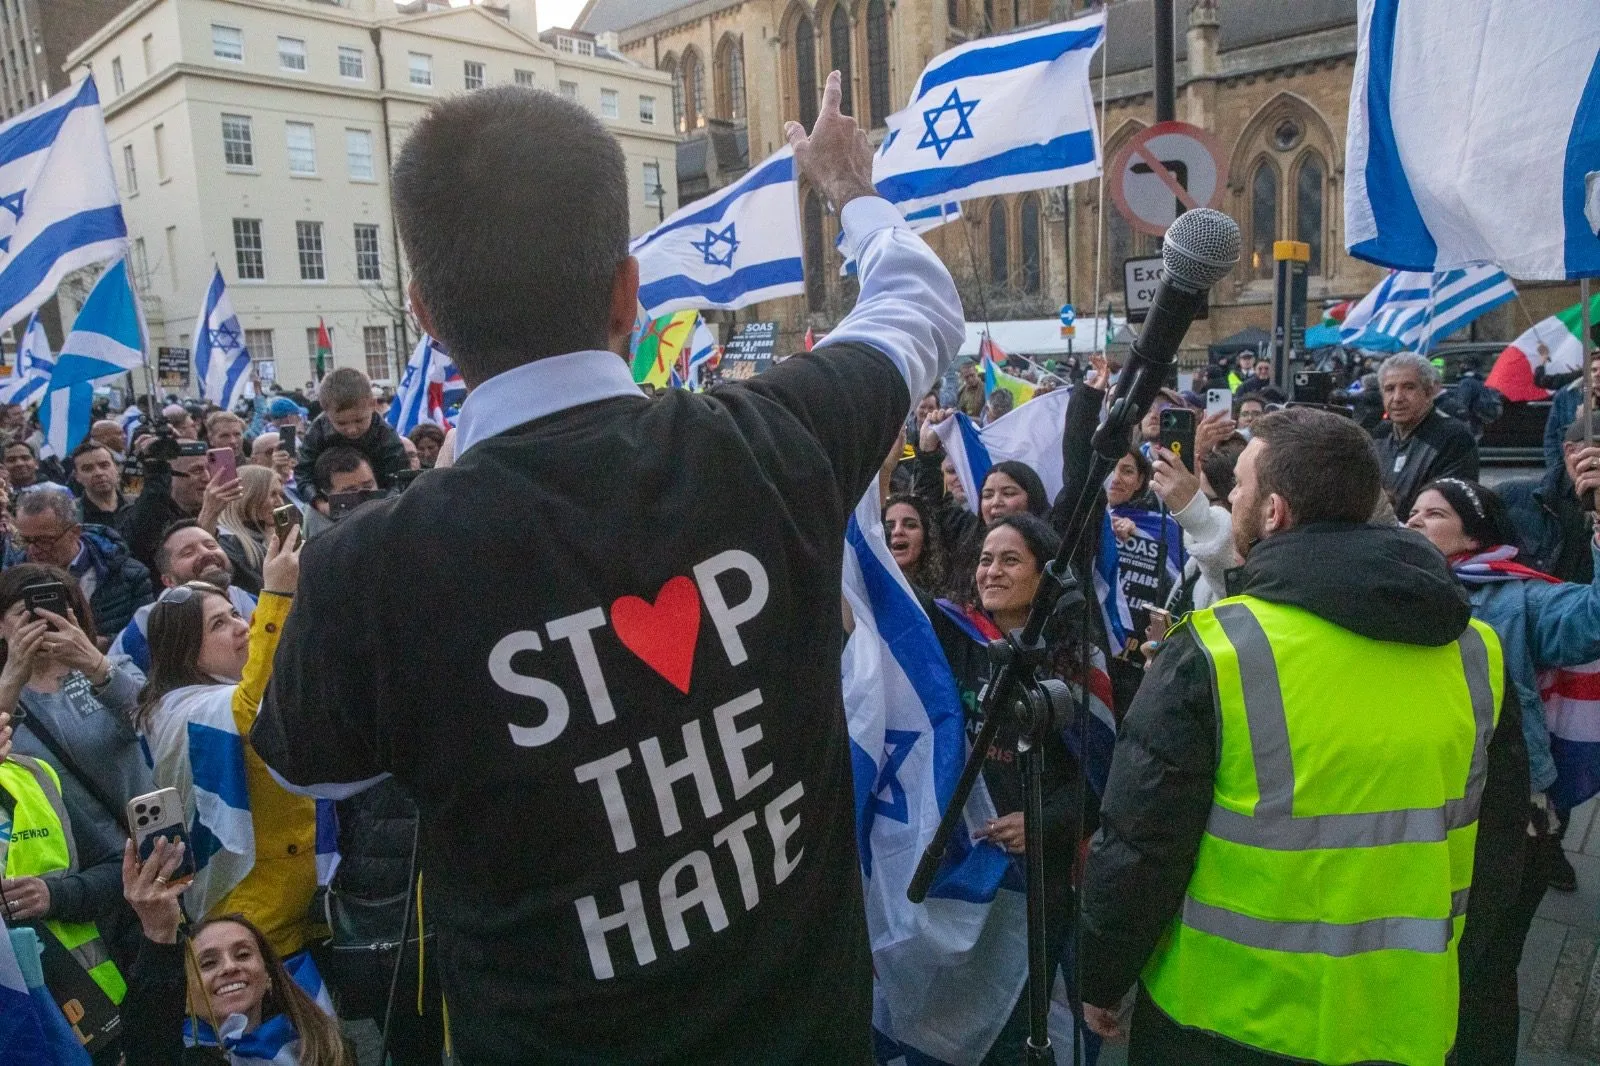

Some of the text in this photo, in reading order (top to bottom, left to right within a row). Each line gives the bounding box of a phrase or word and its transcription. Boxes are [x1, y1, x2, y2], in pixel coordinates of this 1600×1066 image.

[746, 322, 773, 331] SOAS
[1123, 570, 1159, 588] ARABS
[574, 688, 774, 853] THE
[575, 781, 805, 981] HATE
